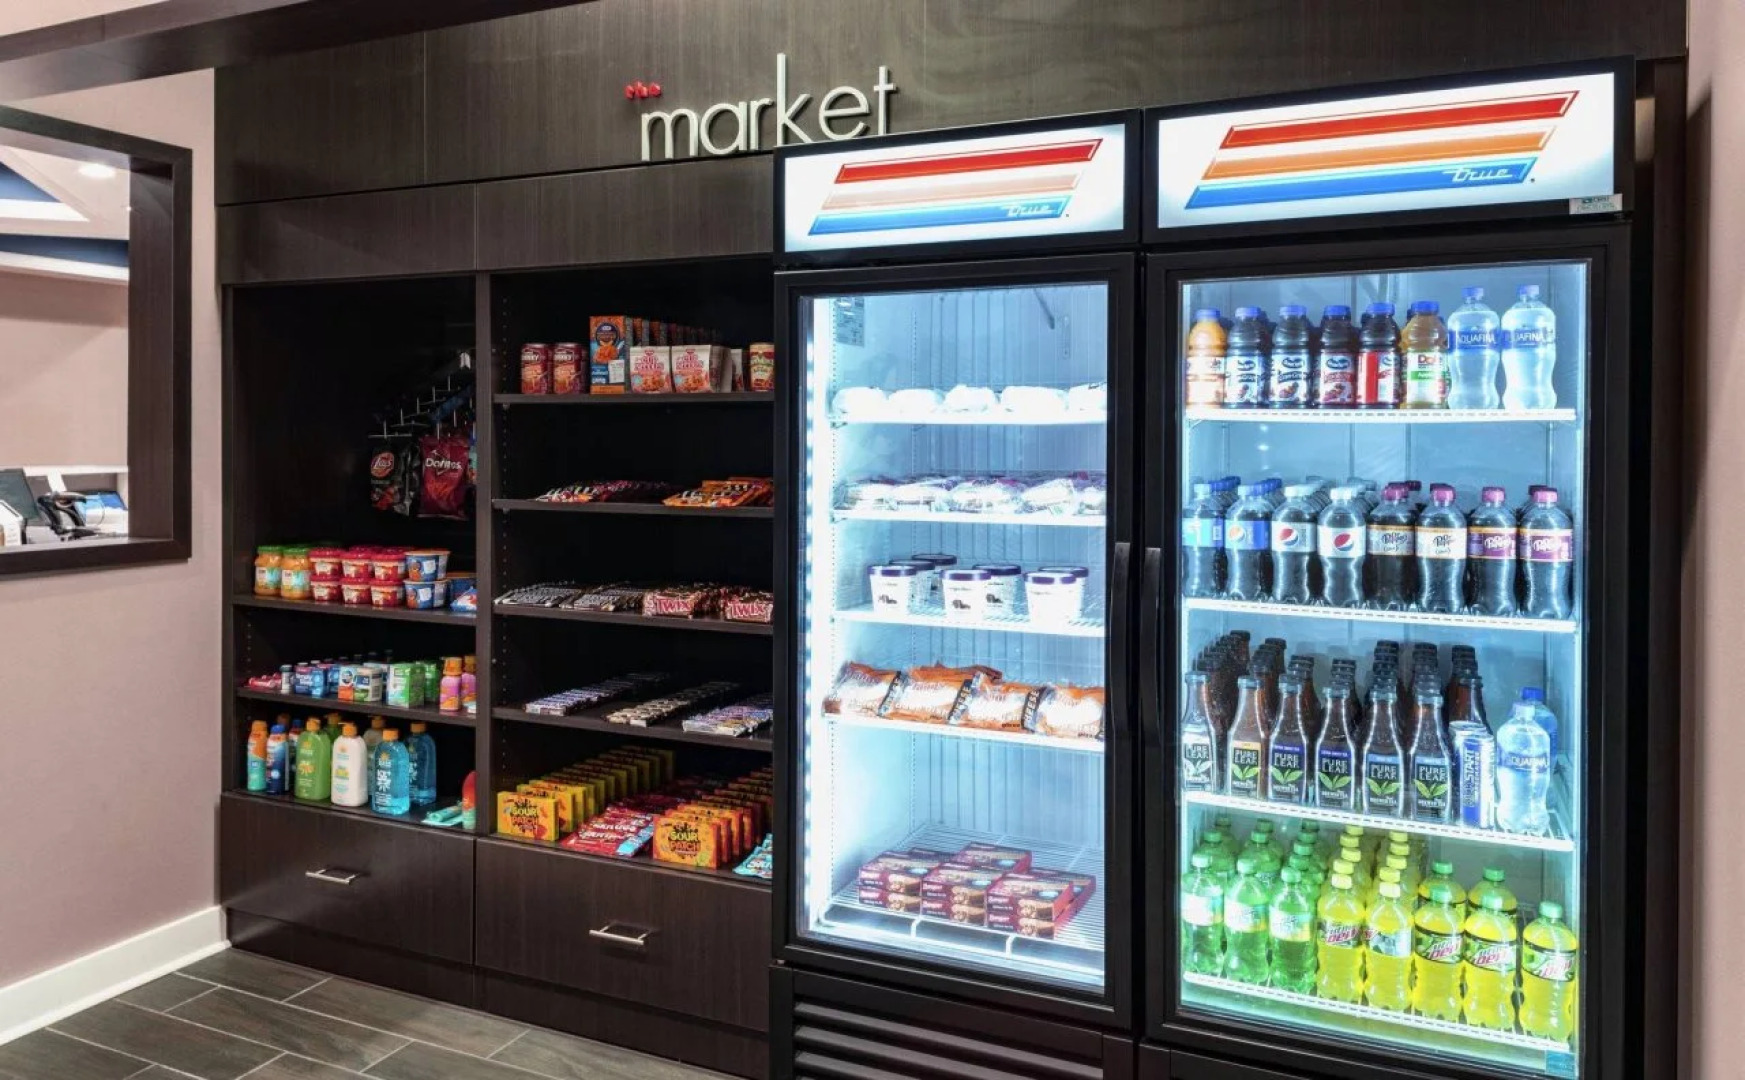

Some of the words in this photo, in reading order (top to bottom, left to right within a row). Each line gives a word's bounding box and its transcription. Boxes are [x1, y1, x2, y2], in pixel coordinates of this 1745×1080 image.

[641, 52, 897, 161] market
[1443, 167, 1513, 182] True
[425, 457, 463, 471] Doritos
[1234, 749, 1258, 757] PURE
[1274, 752, 1299, 761] PURE
[1234, 756, 1258, 765] LEAF
[1274, 760, 1299, 769] LEAF
[1321, 757, 1348, 766] PURE
[1321, 764, 1348, 774] LEAF
[1370, 764, 1397, 773] PURE
[1420, 766, 1446, 774] PURE
[1370, 771, 1397, 780] LEAF
[1420, 772, 1446, 782] LEAF
[511, 805, 538, 817] SOUR
[511, 817, 538, 828] PATCH
[669, 831, 699, 841] SOUR
[670, 840, 700, 851] PATCH
